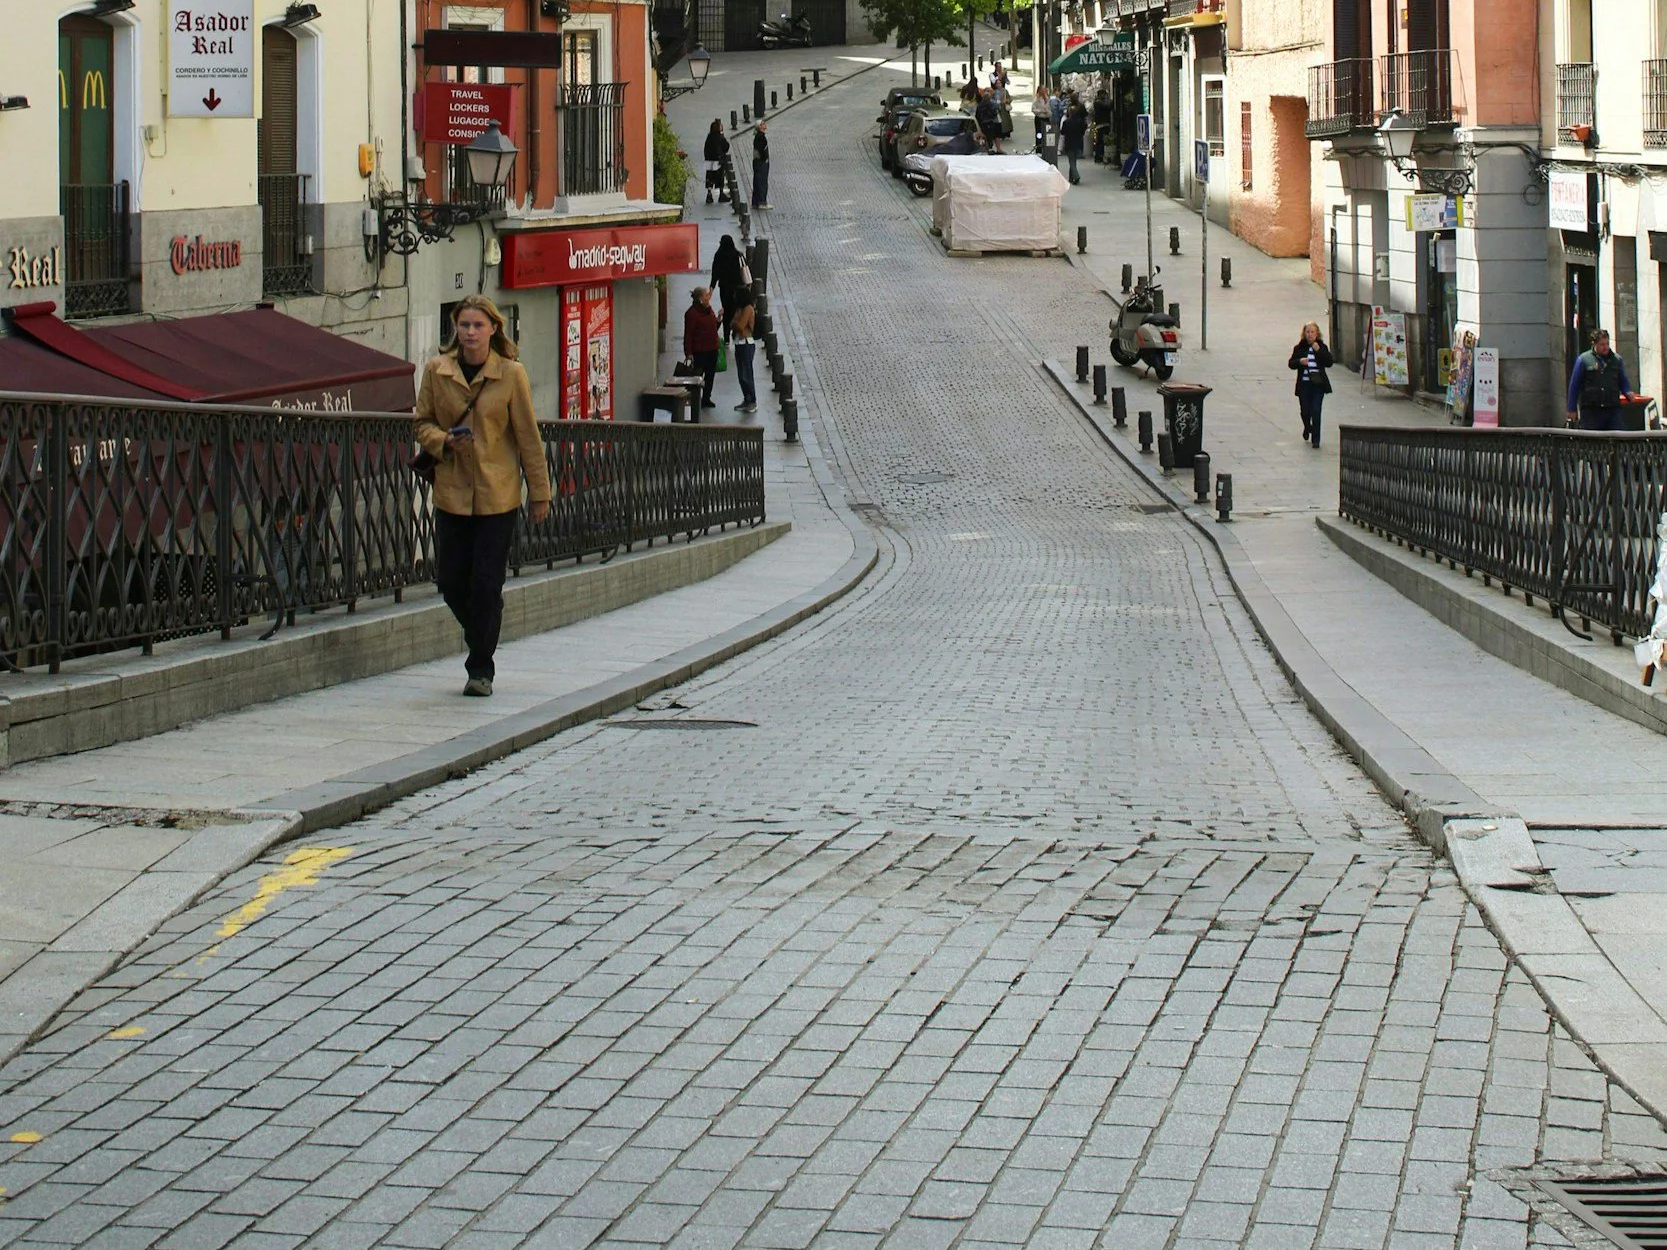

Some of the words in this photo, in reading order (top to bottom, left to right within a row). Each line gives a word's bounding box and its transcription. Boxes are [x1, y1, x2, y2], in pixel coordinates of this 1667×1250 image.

[174, 10, 249, 32] Asador
[191, 35, 234, 54] Real
[451, 90, 483, 100] TRAVEL
[449, 103, 490, 113] LOCKERS
[448, 116, 490, 126] LUGAGGE
[170, 234, 242, 276] Taberna
[8, 245, 62, 290] Real
